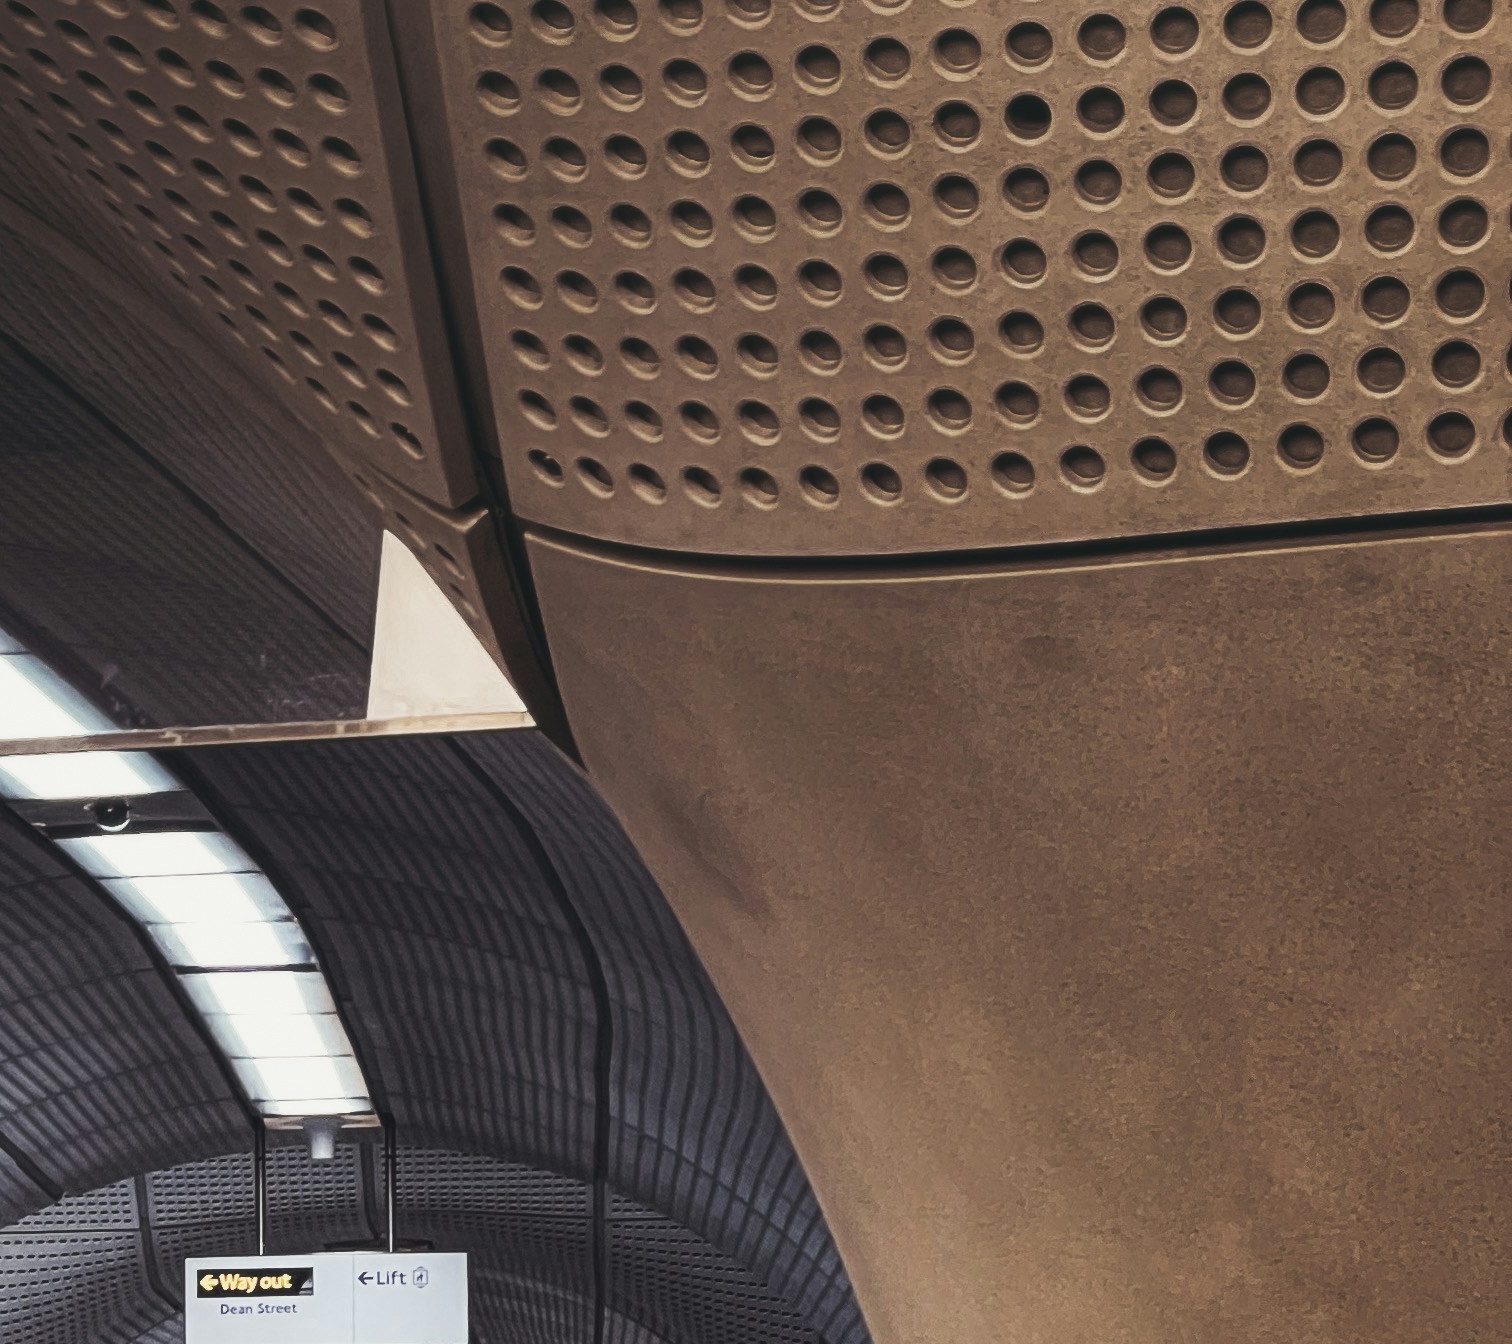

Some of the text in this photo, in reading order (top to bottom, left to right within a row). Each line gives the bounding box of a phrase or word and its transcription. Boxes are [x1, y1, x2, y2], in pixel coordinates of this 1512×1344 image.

[219, 1273, 293, 1293] Way out
[376, 1270, 407, 1285] Lift
[220, 1302, 298, 1315] Dean Street
